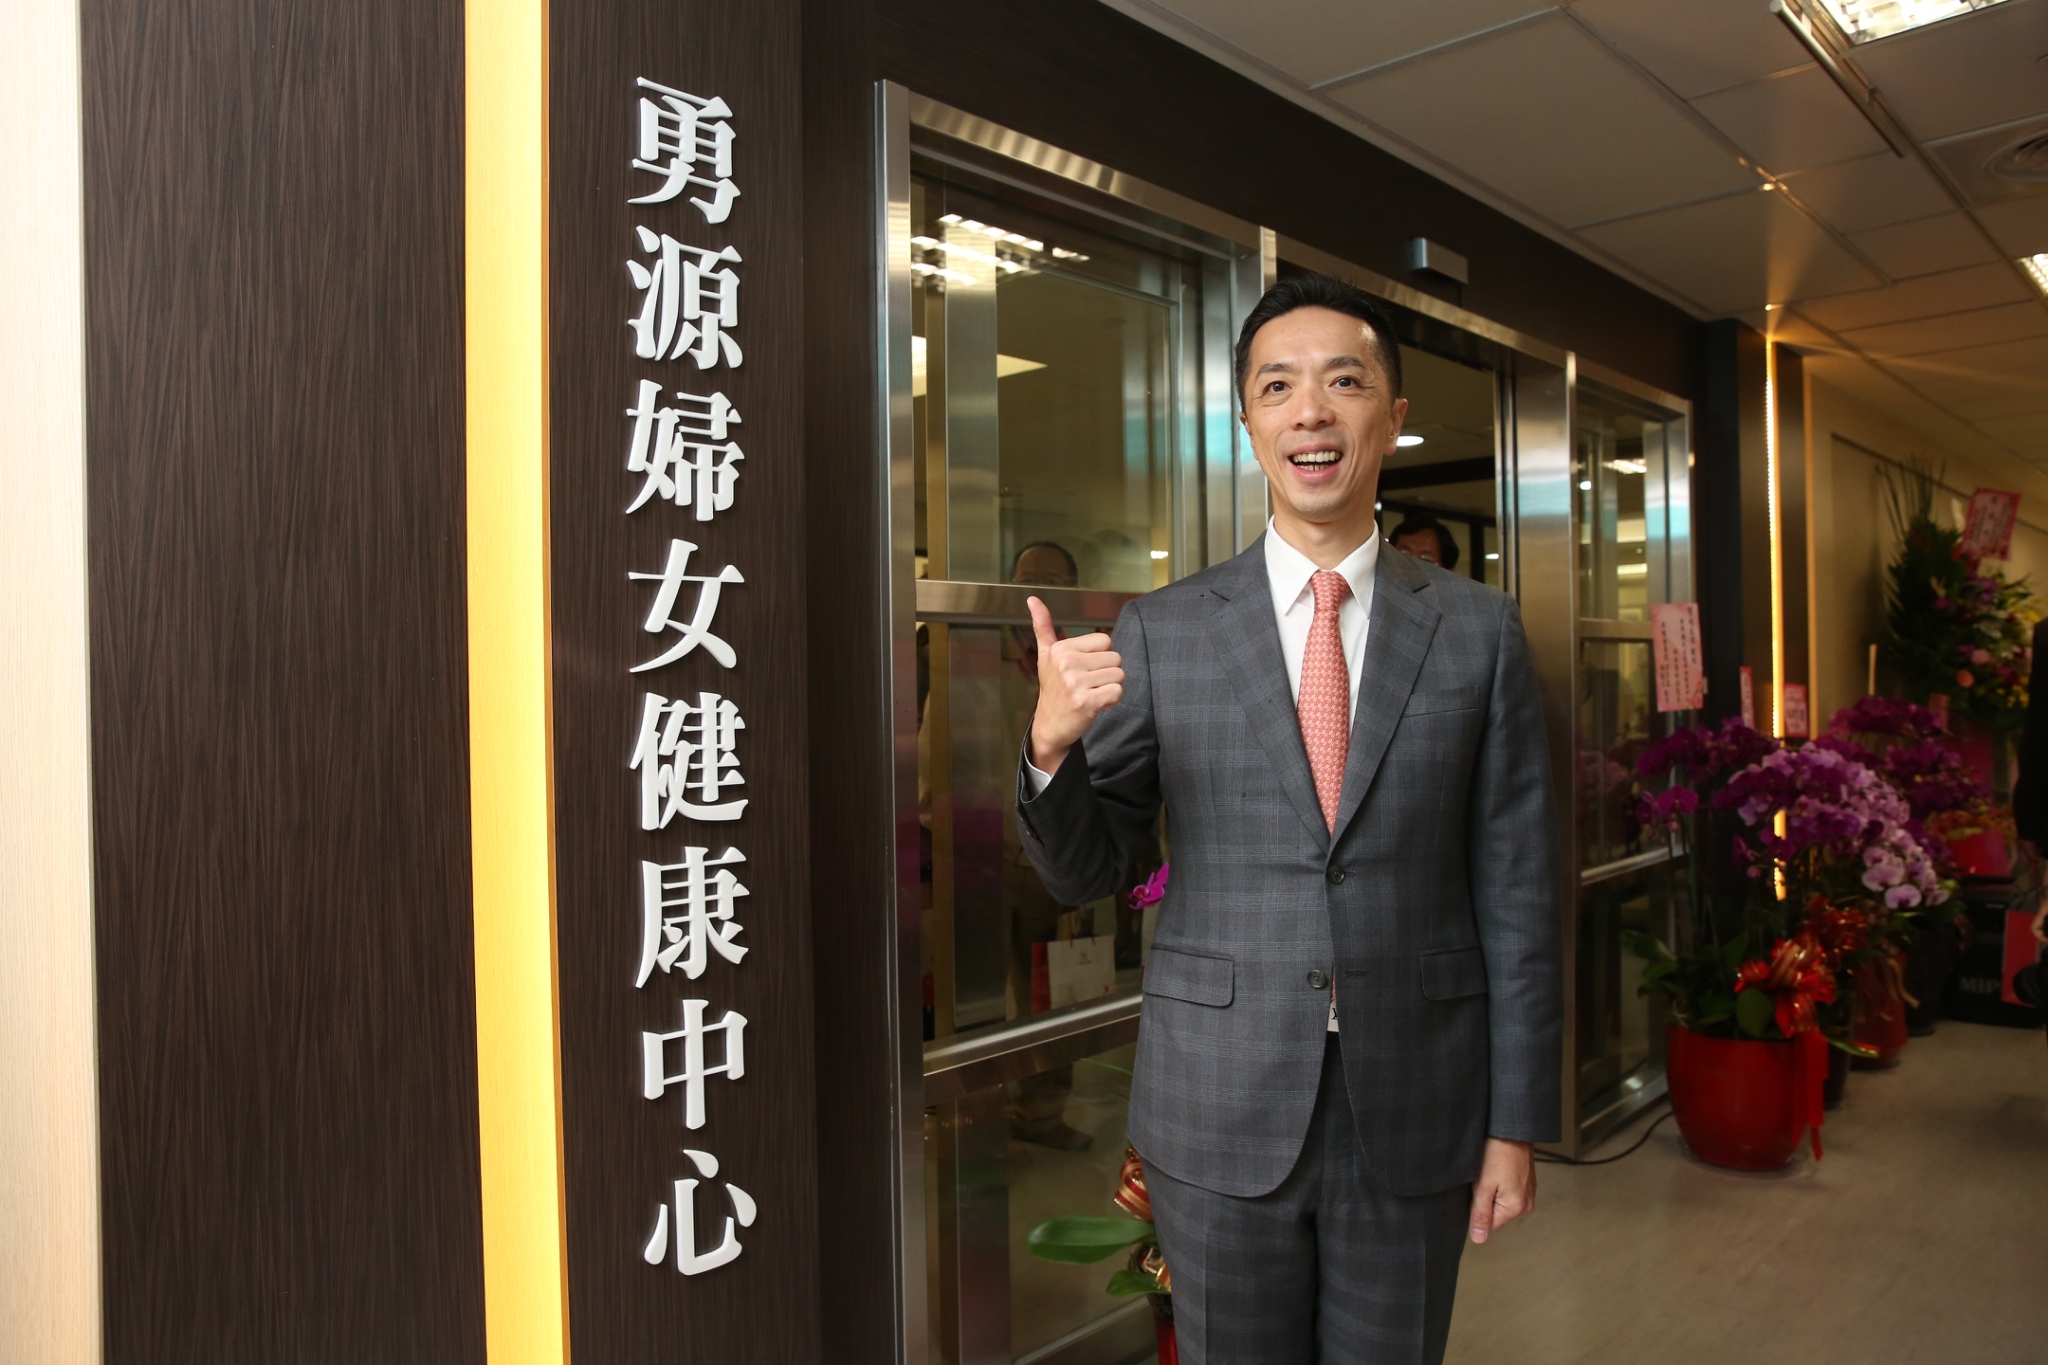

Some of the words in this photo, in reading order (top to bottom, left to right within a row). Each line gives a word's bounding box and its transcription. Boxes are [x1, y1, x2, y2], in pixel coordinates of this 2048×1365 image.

[626, 76, 757, 1276] 勇源婦女健康中心
